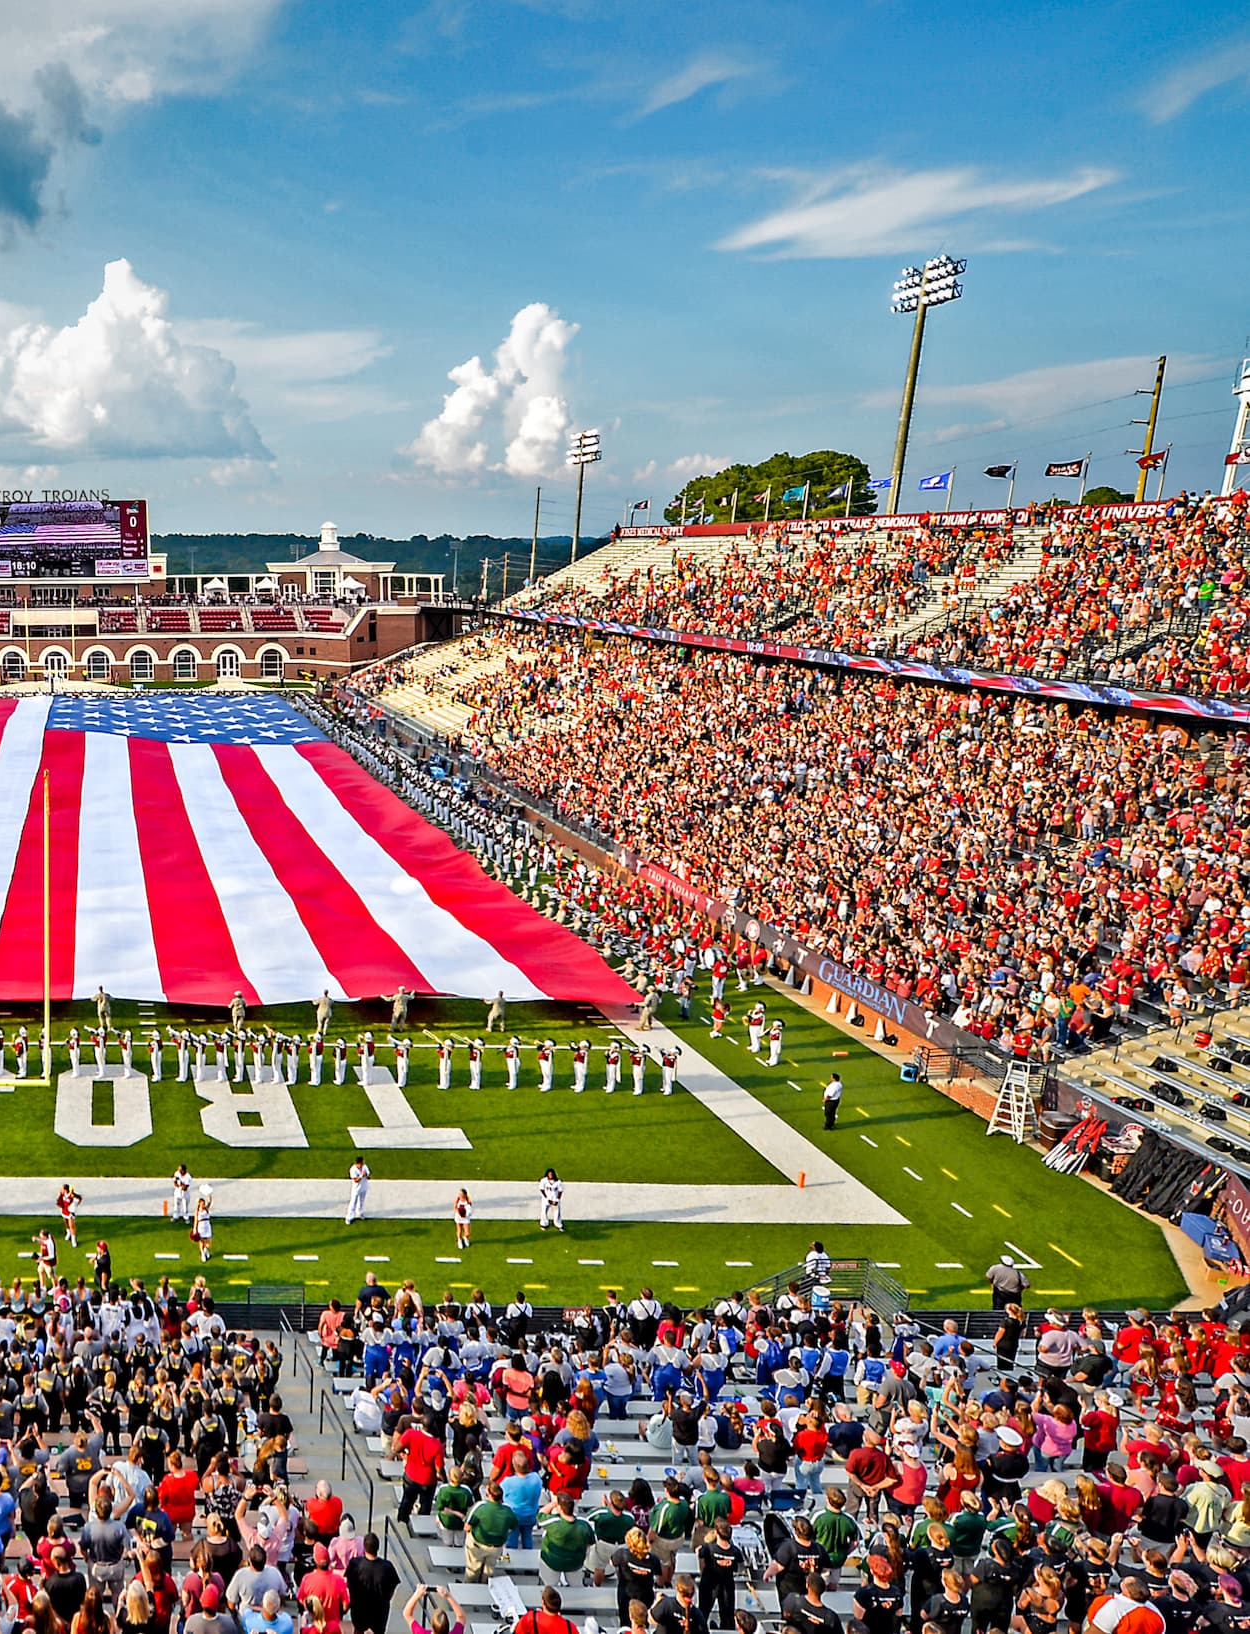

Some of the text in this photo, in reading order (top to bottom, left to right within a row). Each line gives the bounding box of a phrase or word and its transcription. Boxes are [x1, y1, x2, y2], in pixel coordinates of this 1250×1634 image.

[41, 488, 110, 502] TROJANS
[129, 516, 138, 528] 0
[875, 515, 920, 528] MEMORIAL
[637, 526, 661, 536] MEDICAL
[11, 561, 37, 570] 18:10
[746, 641, 765, 653] 10:00
[647, 867, 700, 904] TROY TROJANS
[818, 958, 908, 1025] GUARDIAN
[858, 995, 884, 1013] UNION
